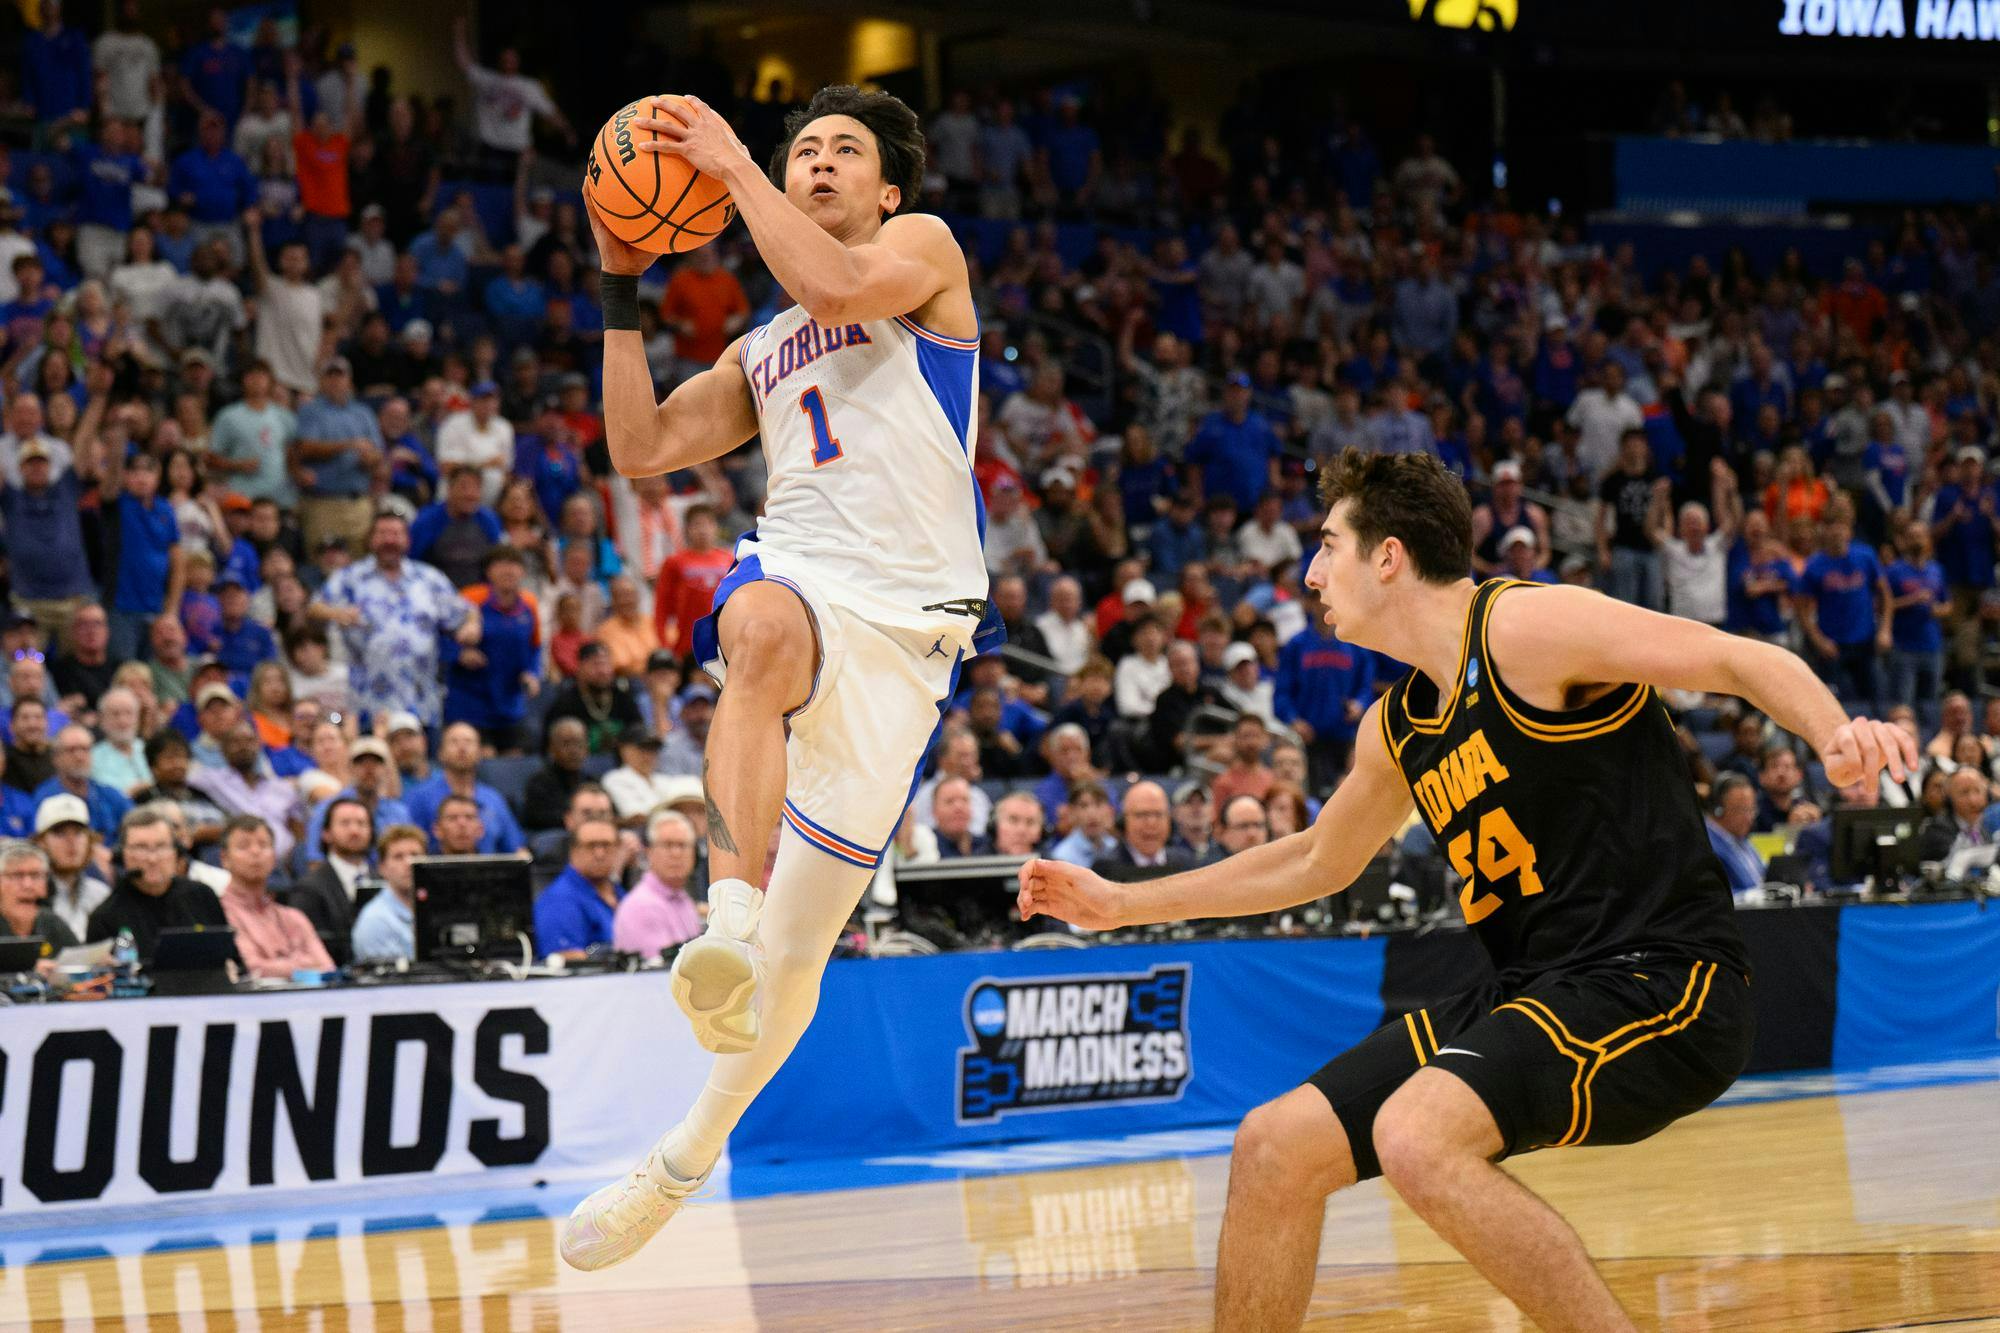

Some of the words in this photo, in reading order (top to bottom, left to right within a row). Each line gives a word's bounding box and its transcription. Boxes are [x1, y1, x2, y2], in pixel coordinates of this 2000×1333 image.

[1778, 0, 1906, 38] IOWA
[751, 318, 872, 416] FLORIDA
[799, 385, 844, 468] 1
[1413, 729, 1510, 835] IOWA
[1448, 806, 1545, 926] 24
[1006, 983, 1128, 1039] MARCH
[1024, 1031, 1188, 1090] MADNESS
[0, 1007, 550, 1208] OUNDS
